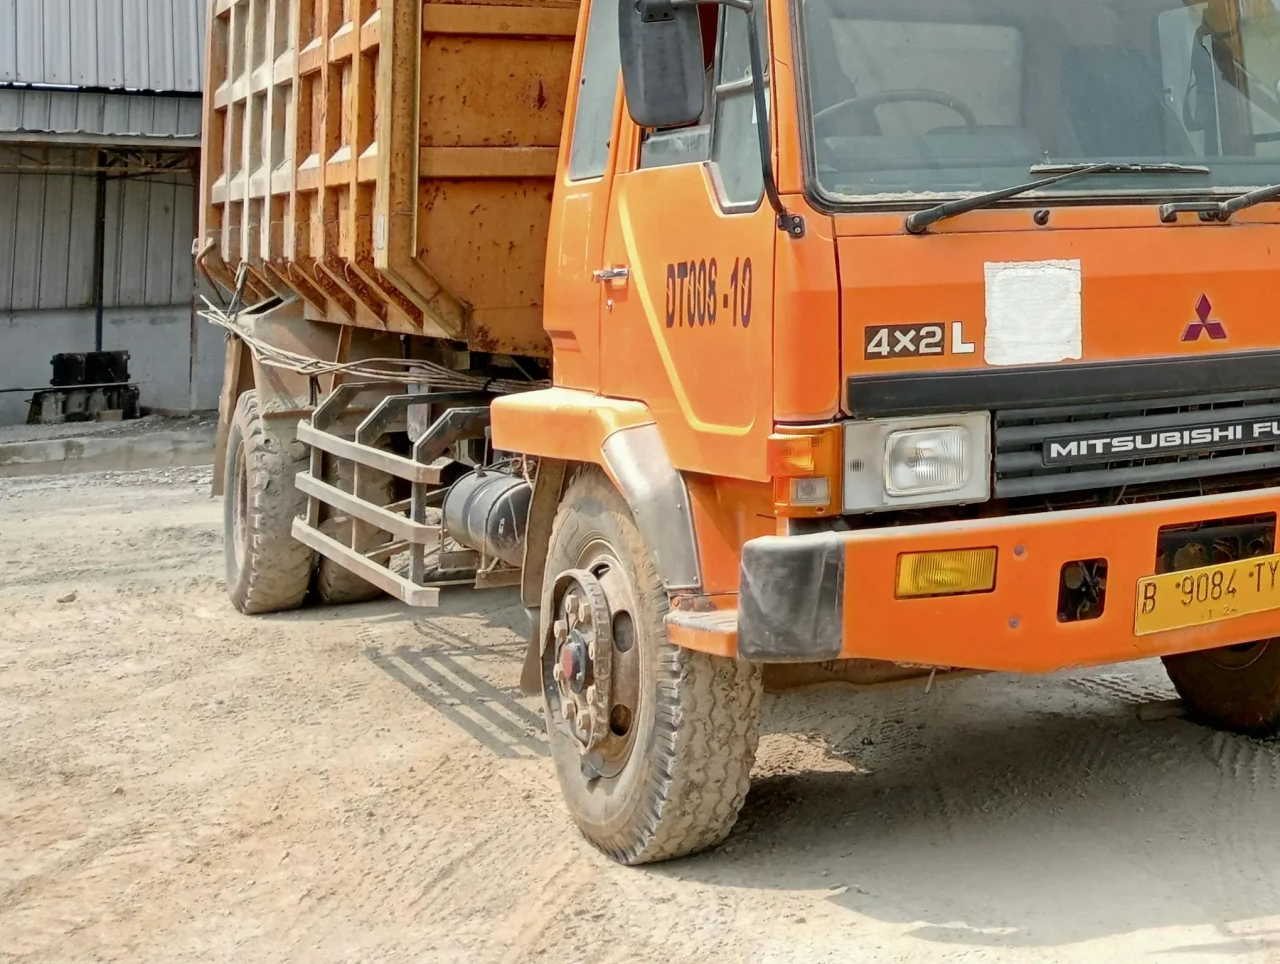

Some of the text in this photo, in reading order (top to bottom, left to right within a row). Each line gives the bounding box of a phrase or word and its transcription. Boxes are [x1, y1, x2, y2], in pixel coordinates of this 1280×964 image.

[1049, 424, 1243, 458] MITSUBISHI
[1141, 582, 1157, 614] B
[1180, 568, 1238, 606] 9084
